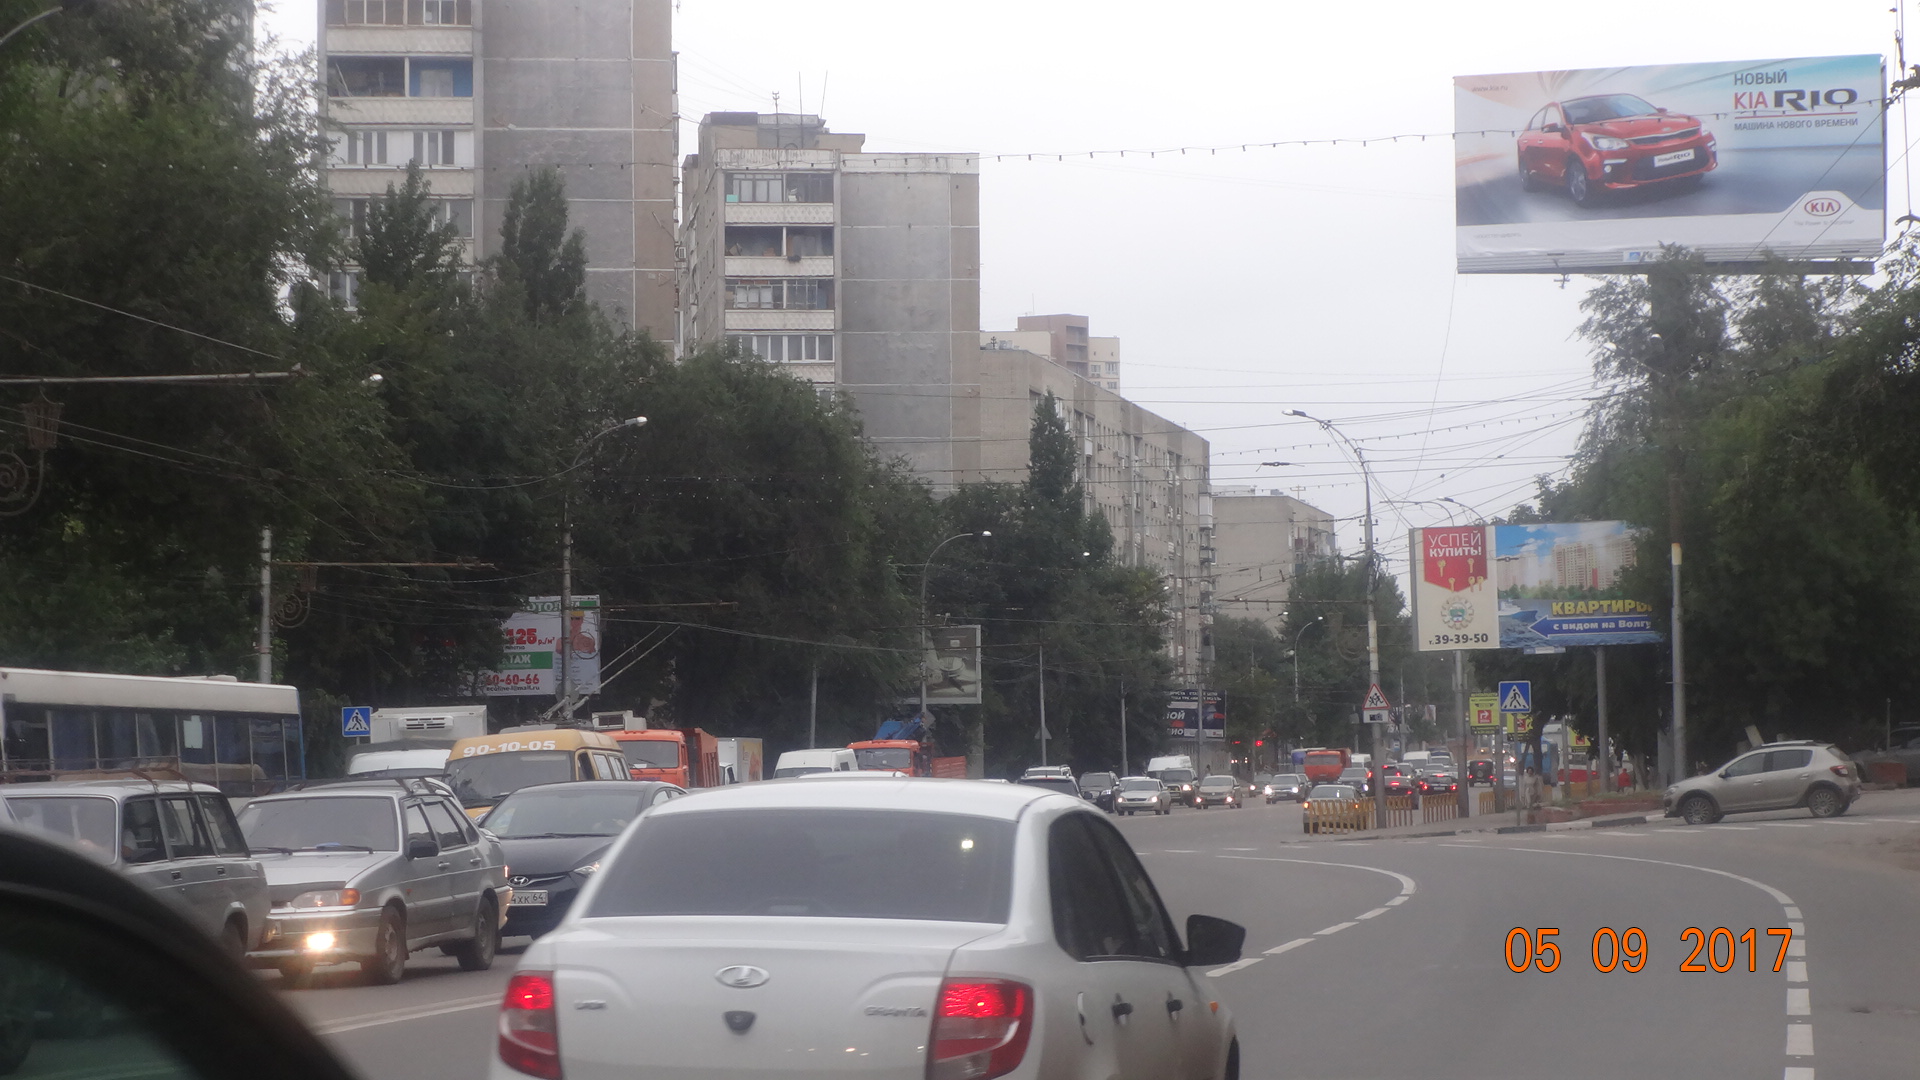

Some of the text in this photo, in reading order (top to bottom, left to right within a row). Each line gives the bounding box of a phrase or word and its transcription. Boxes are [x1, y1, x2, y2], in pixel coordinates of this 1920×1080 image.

[1734, 69, 1787, 85] НОВЫЙ
[1734, 88, 1858, 111] KIA RIO
[1734, 118, 1858, 131] МАШИНА НОВОГО ВРЕМЕНИ
[1810, 202, 1835, 213] KIA
[1428, 530, 1481, 548] УСПЕЙ
[1429, 547, 1482, 557] КУПИТЬ!
[1553, 623, 1560, 631] с
[1562, 622, 1598, 631] видом
[1618, 620, 1651, 630] Волгу
[463, 740, 556, 758] 90-10-05
